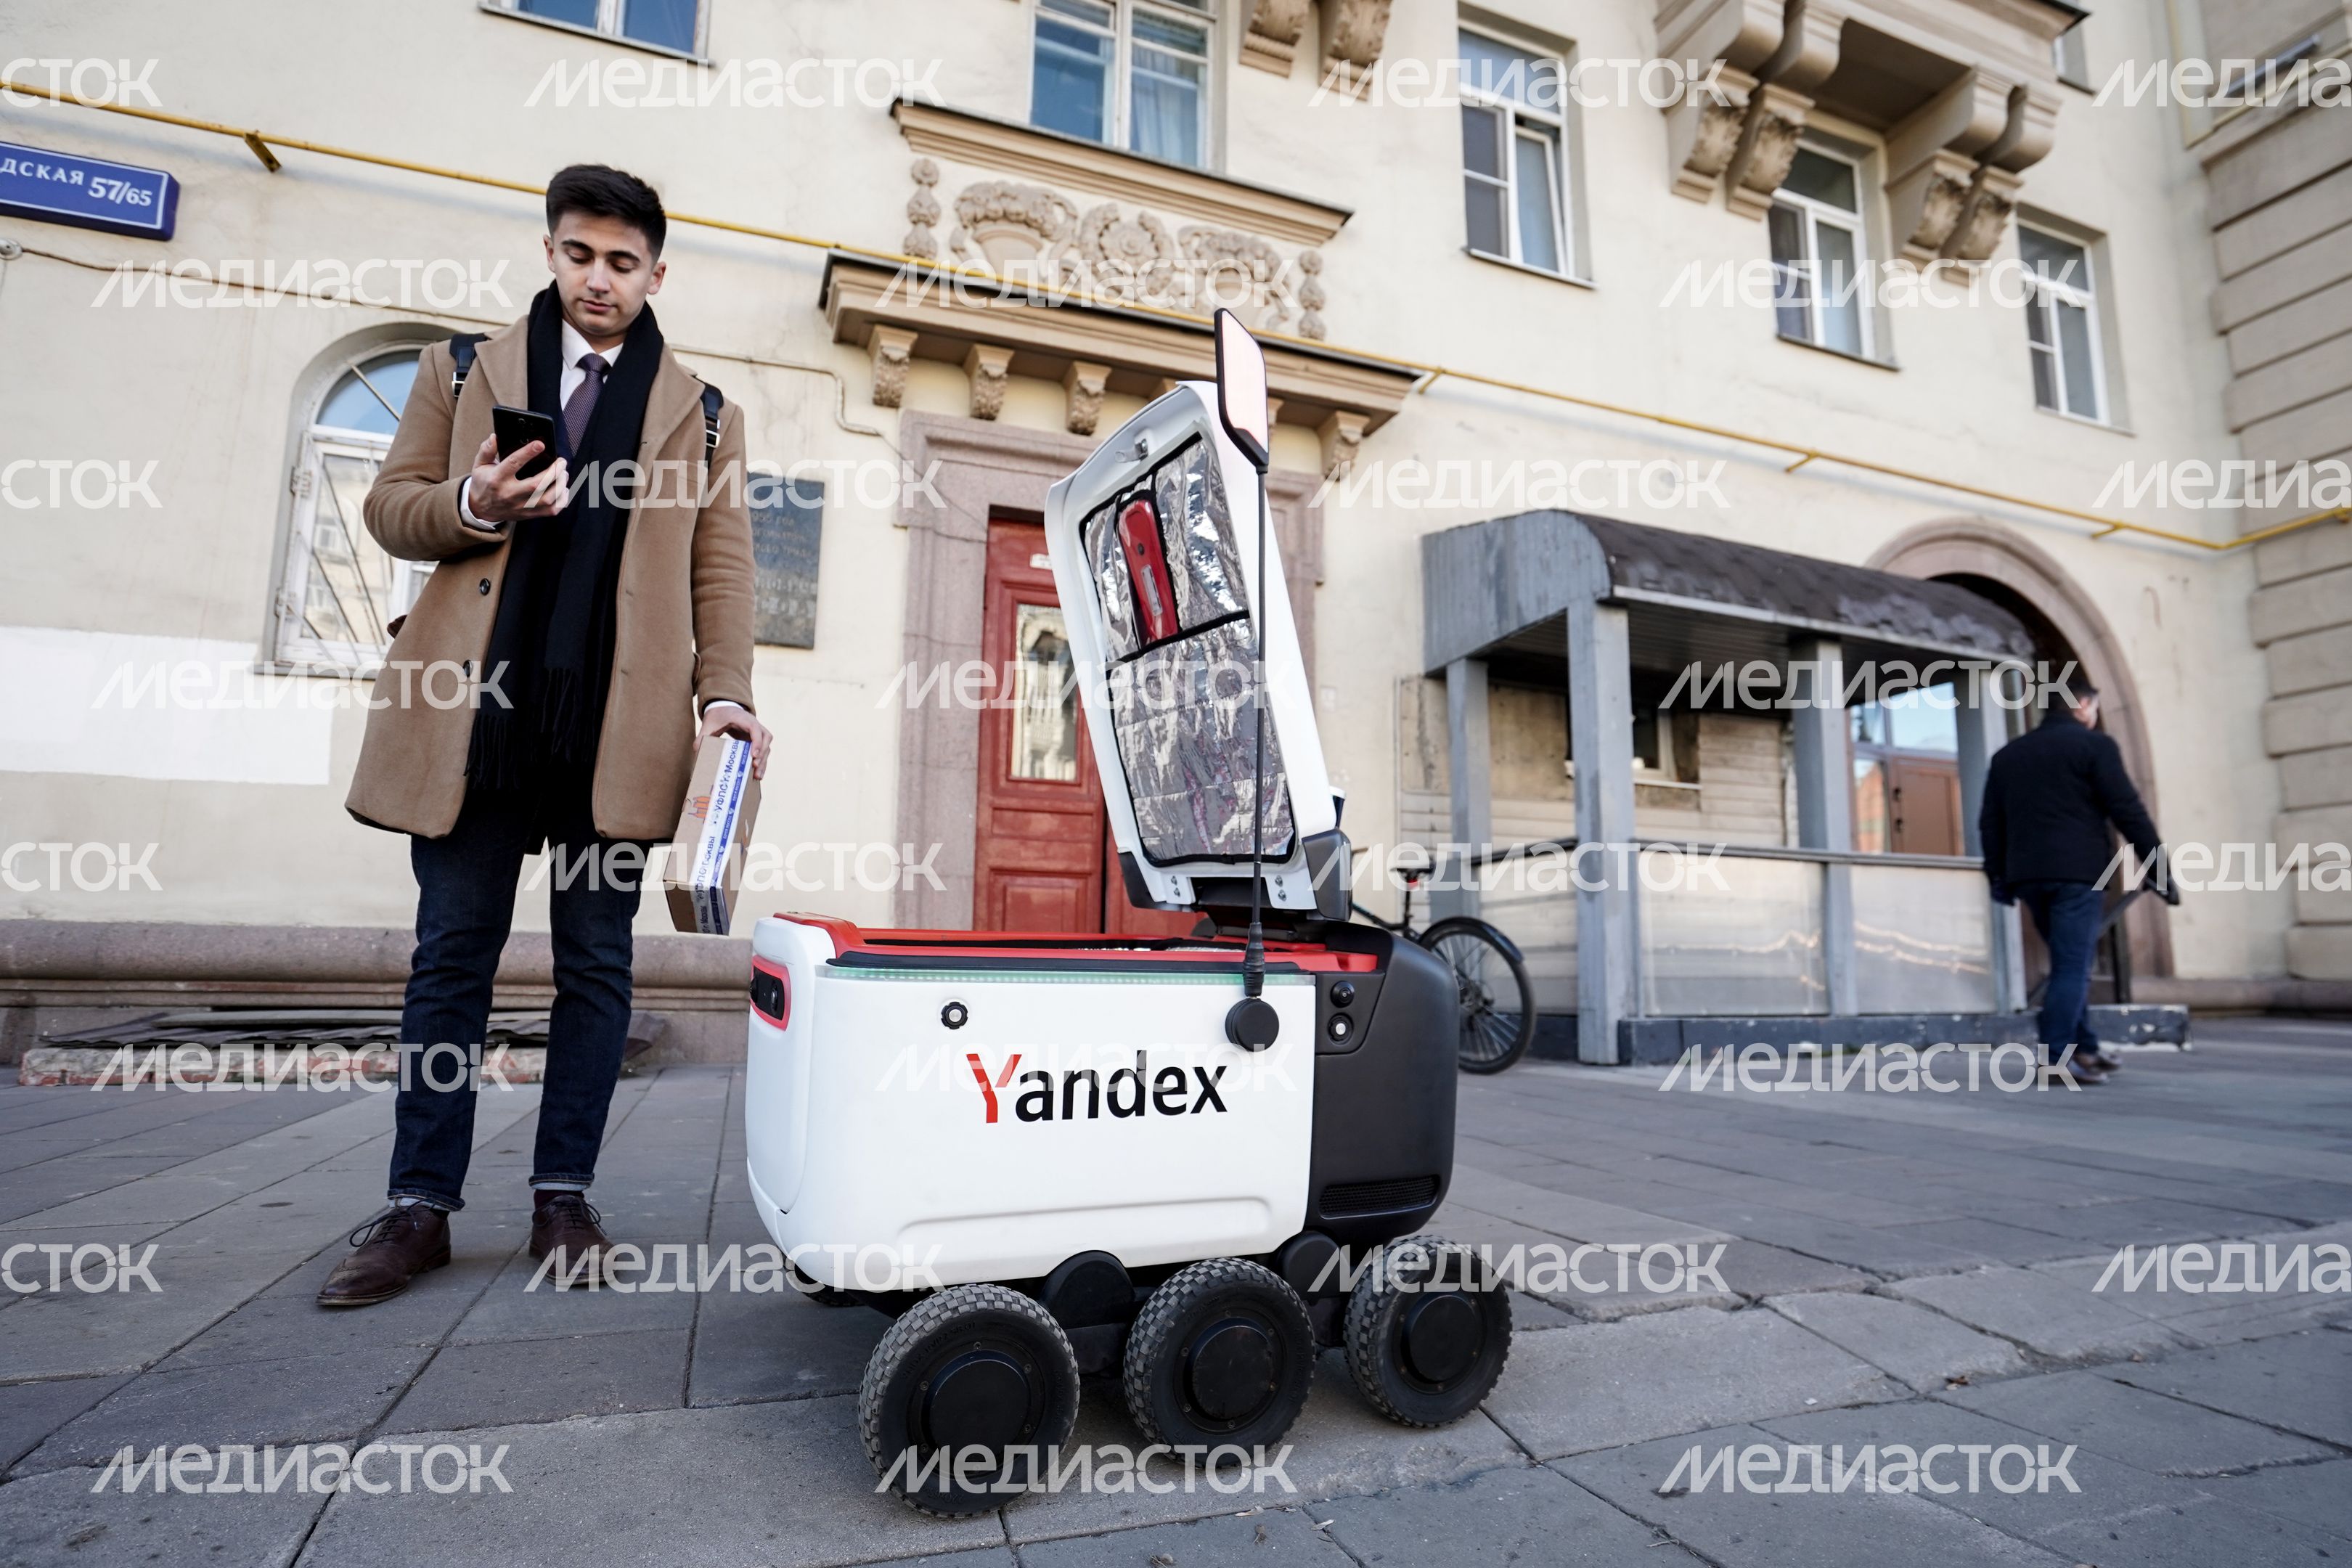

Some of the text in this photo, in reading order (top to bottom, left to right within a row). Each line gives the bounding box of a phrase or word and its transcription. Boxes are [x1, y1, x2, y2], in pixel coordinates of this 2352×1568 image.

[0, 158, 152, 206] ДСКАЯ 57/65
[966, 1050, 1228, 1124] Yandex
